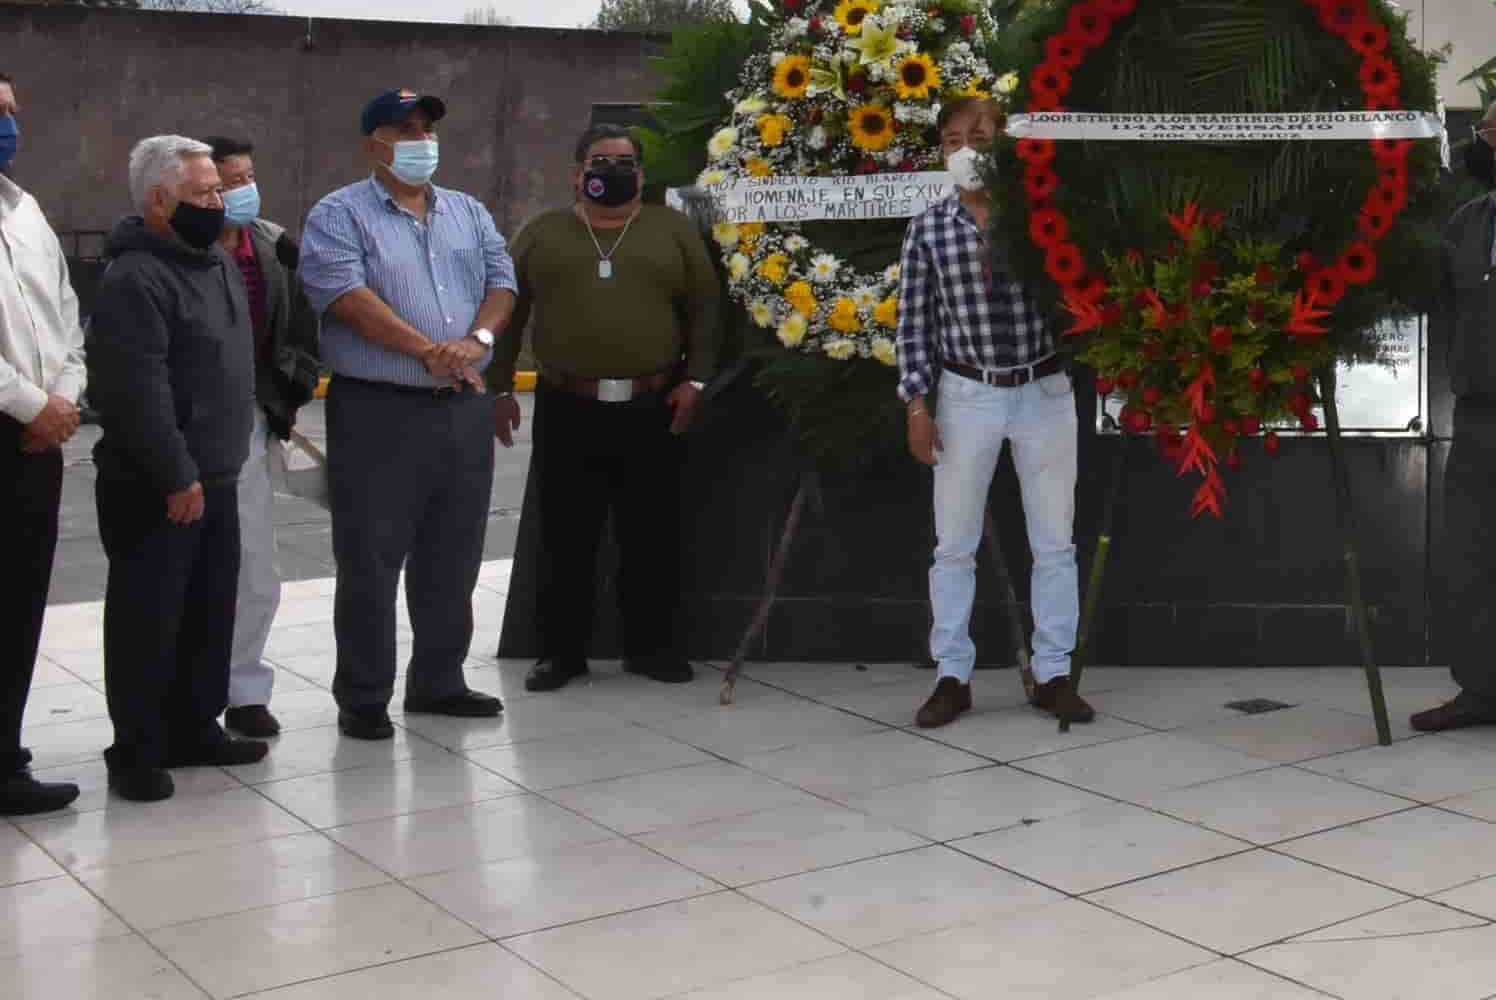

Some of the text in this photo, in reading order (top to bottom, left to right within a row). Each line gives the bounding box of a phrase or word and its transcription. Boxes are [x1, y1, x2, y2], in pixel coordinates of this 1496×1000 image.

[1030, 114, 1073, 123] LOOR
[1077, 114, 1143, 123] ETERNO
[1145, 114, 1158, 123] A
[1161, 114, 1192, 123] LOS
[1288, 114, 1315, 124] DE
[1350, 111, 1417, 122] BLANCO
[743, 187, 832, 206] HOMENAJE
[843, 186, 865, 202] EN
[873, 186, 896, 201] SU
[903, 184, 943, 201] CXIV
[755, 204, 766, 221] A
[776, 202, 809, 219] LOS
